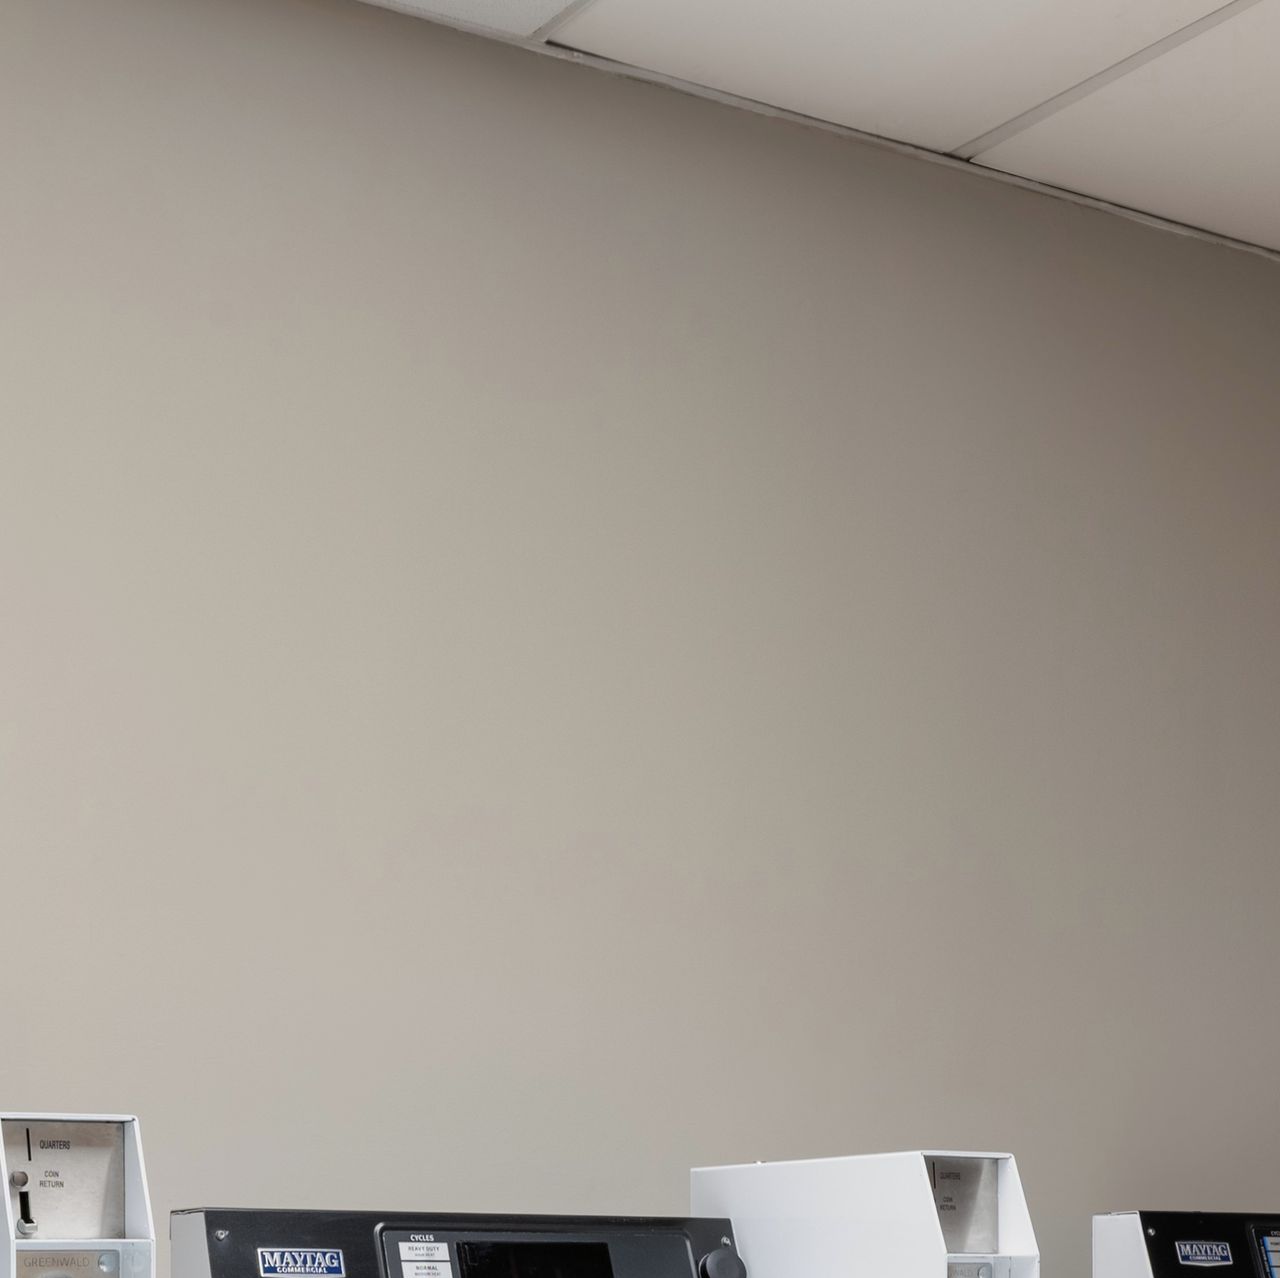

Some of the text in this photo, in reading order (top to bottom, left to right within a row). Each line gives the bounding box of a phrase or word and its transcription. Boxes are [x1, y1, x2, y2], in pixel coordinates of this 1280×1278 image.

[39, 1140, 71, 1150] QUARTERS
[44, 1170, 60, 1178] COIN
[39, 1180, 65, 1188] RETURN
[410, 1234, 435, 1242] CYCLES
[1180, 1244, 1228, 1257] MAYTAG
[23, 1256, 90, 1268] GREENWALD
[263, 1251, 340, 1268] MAYTAG
[276, 1266, 329, 1274] COMMERCIAL
